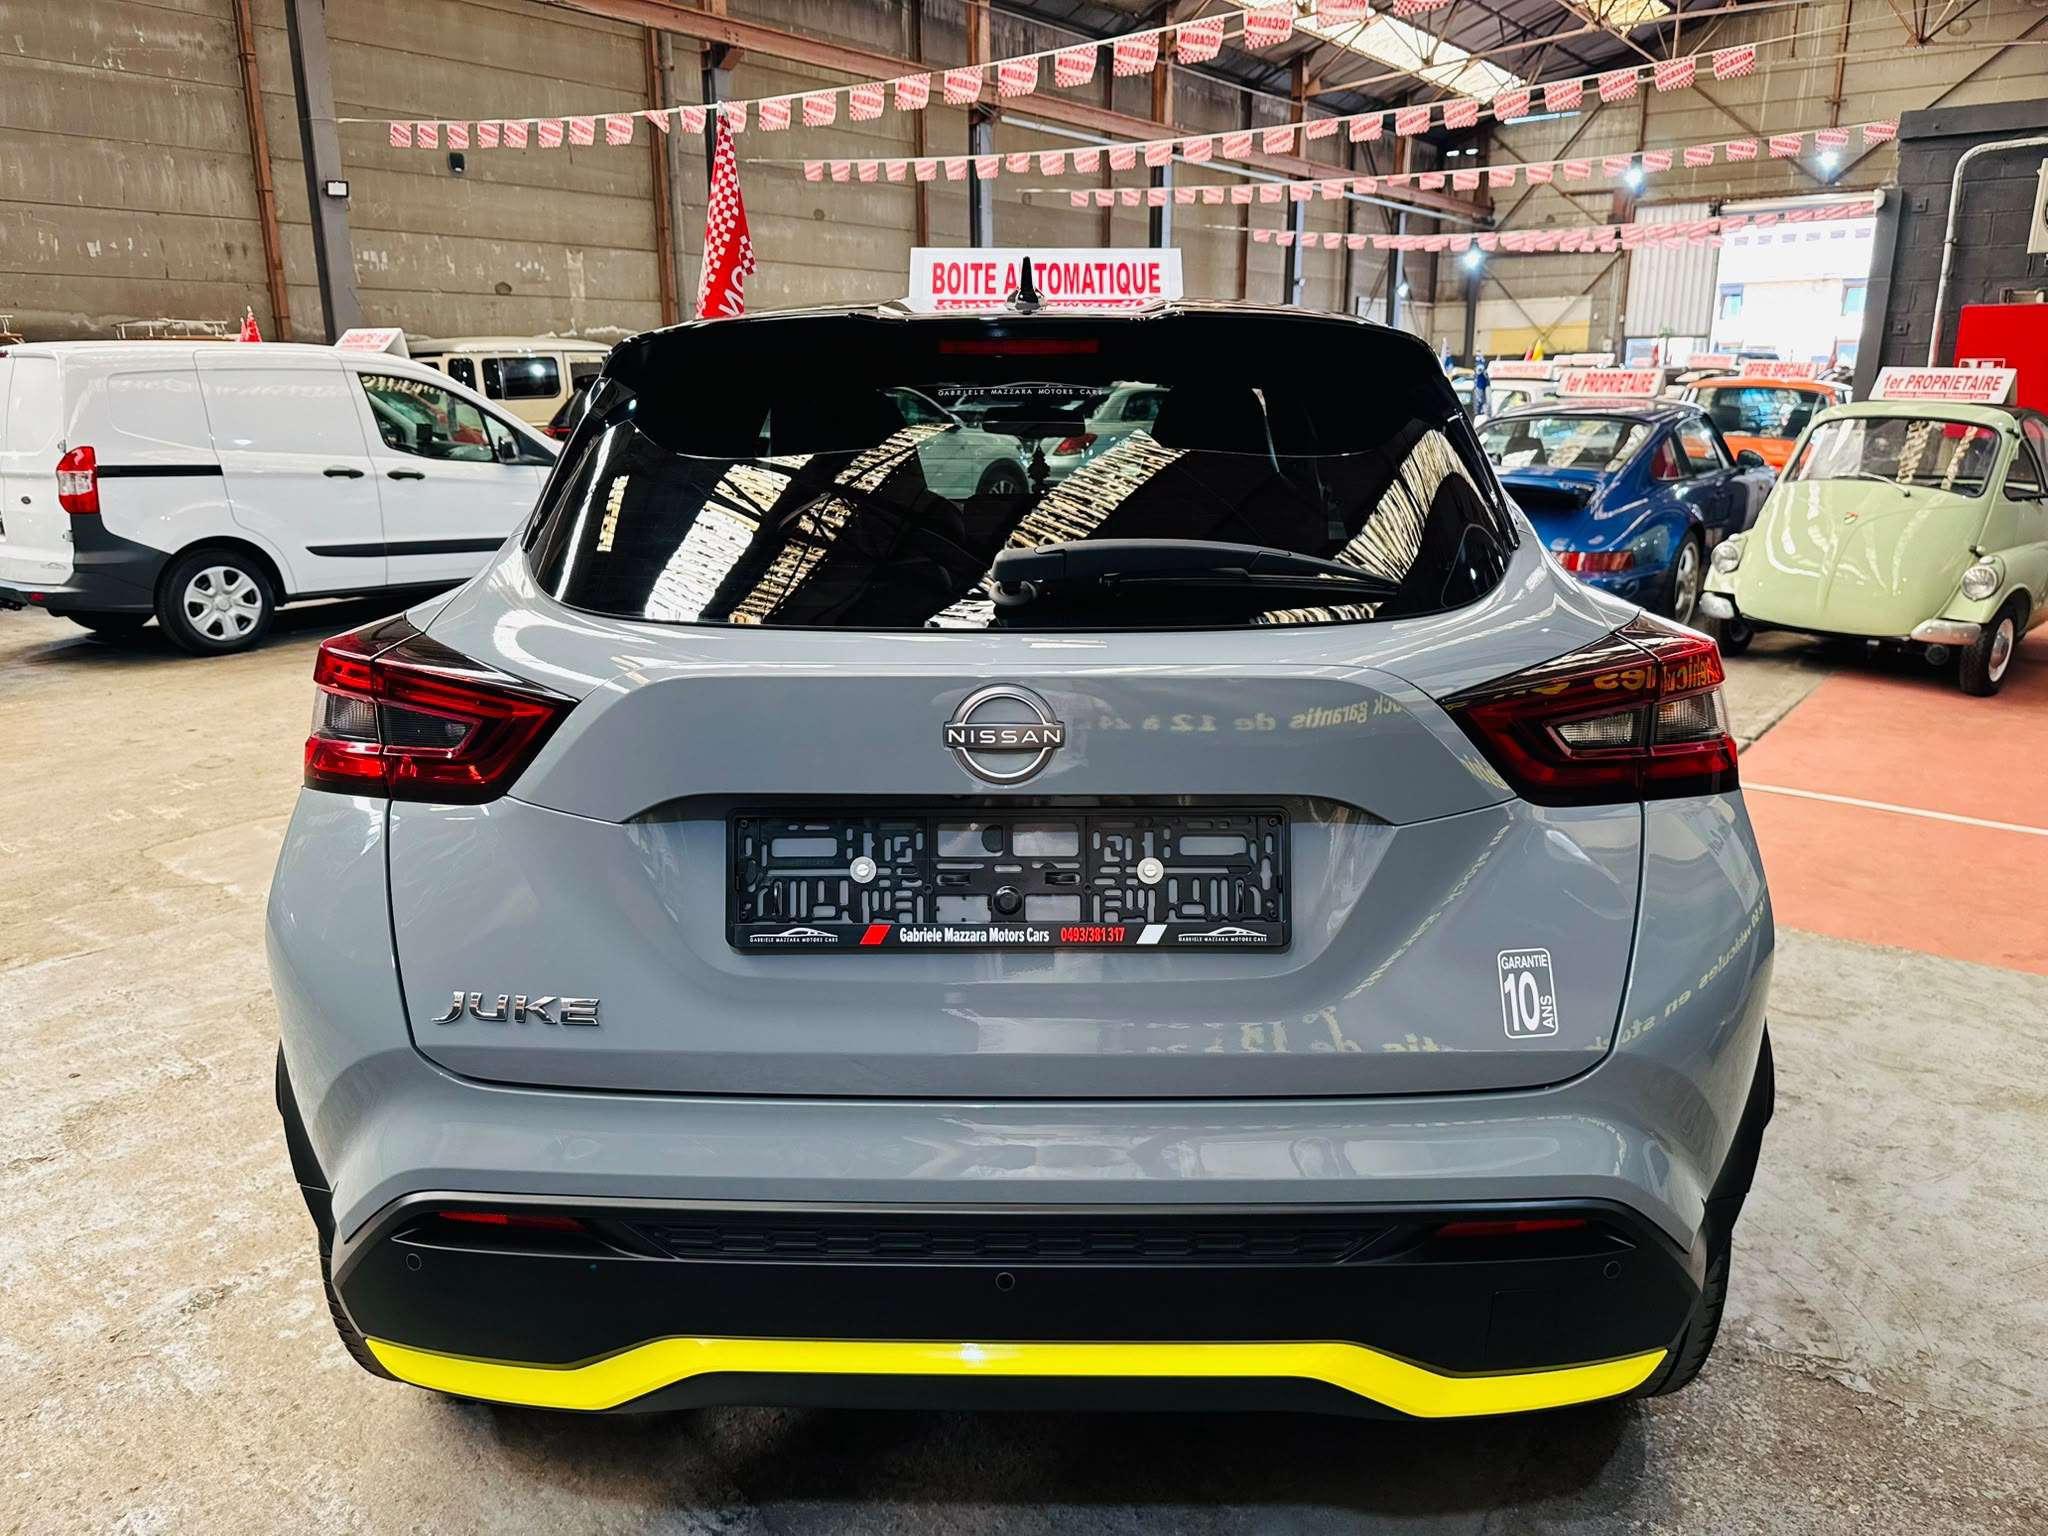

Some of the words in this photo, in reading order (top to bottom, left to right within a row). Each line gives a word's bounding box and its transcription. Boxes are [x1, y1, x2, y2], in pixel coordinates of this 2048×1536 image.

[932, 262, 997, 295] BOITE
[1003, 262, 1161, 296] ATOMATIQUE
[938, 388, 985, 396] GABRIELE
[1565, 373, 1582, 392] 1er
[1582, 372, 1656, 393] PROPRIETAIRE
[1884, 375, 1905, 390] 1er
[1905, 375, 2004, 392] PROPRIETAIRE
[948, 729, 1061, 744] NISSAN
[900, 927, 943, 942] Gabriele
[944, 927, 987, 942] Mazzara
[989, 927, 1025, 942] Motors
[1027, 927, 1049, 942] Cars
[1501, 954, 1549, 970] GARANTIE
[431, 990, 601, 1026] JUKE
[1503, 970, 1540, 1032] 10
[1540, 994, 1556, 1029] ANS
